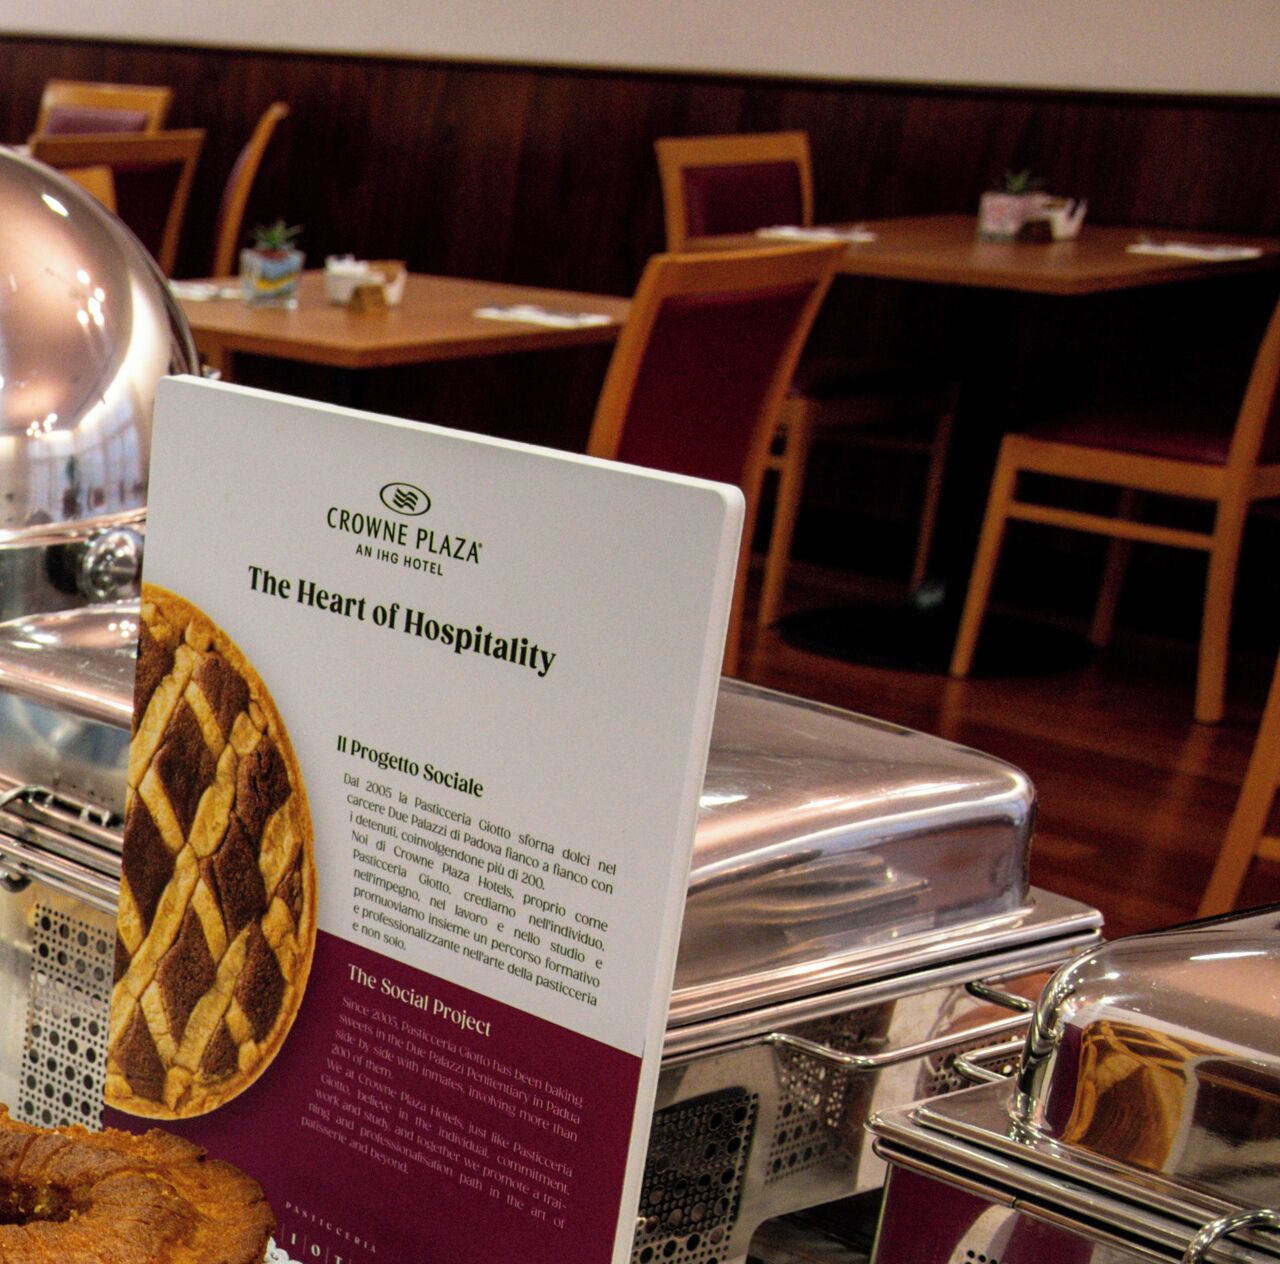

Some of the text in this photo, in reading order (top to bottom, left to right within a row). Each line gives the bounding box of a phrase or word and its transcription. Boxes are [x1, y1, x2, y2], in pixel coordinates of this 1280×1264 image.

[326, 506, 409, 547] CROWNE
[355, 543, 443, 577] AN IHG HOTEL
[248, 565, 557, 678] The Heart of Hospitality
[336, 734, 484, 798] Il Progetto Sociale
[343, 772, 617, 876] Dal 2005 la Pasticceria Giotto sforna dolci nel
[346, 794, 614, 895] carcere Due Palazzi di Padova fianco a fianco con
[349, 811, 353, 822] i
[400, 831, 485, 869] coinvolgendone
[486, 861, 505, 876] più
[507, 868, 519, 881] di
[351, 829, 369, 846] Noi
[375, 840, 386, 852] di
[393, 845, 435, 870] Crowne
[441, 862, 470, 883] Plaza
[522, 893, 567, 917] proprio
[574, 912, 609, 933] come
[352, 848, 408, 878] Pasticceria
[463, 891, 517, 918] crediamo
[351, 921, 360, 932] e
[361, 925, 381, 941] non
[352, 904, 360, 914] e
[361, 907, 461, 954] professionalizzante
[506, 963, 534, 982] della
[535, 974, 598, 1007] pasticceria
[353, 886, 601, 988] promuoviamo insieme un percorso formativo
[429, 896, 447, 911] nel
[454, 904, 489, 926] lavoro
[496, 922, 505, 933] e
[513, 928, 541, 946] nello
[549, 941, 586, 963] studio
[594, 959, 604, 970] e
[349, 964, 491, 1037] The Social Project
[285, 1201, 377, 1254] PASTICCERIA
